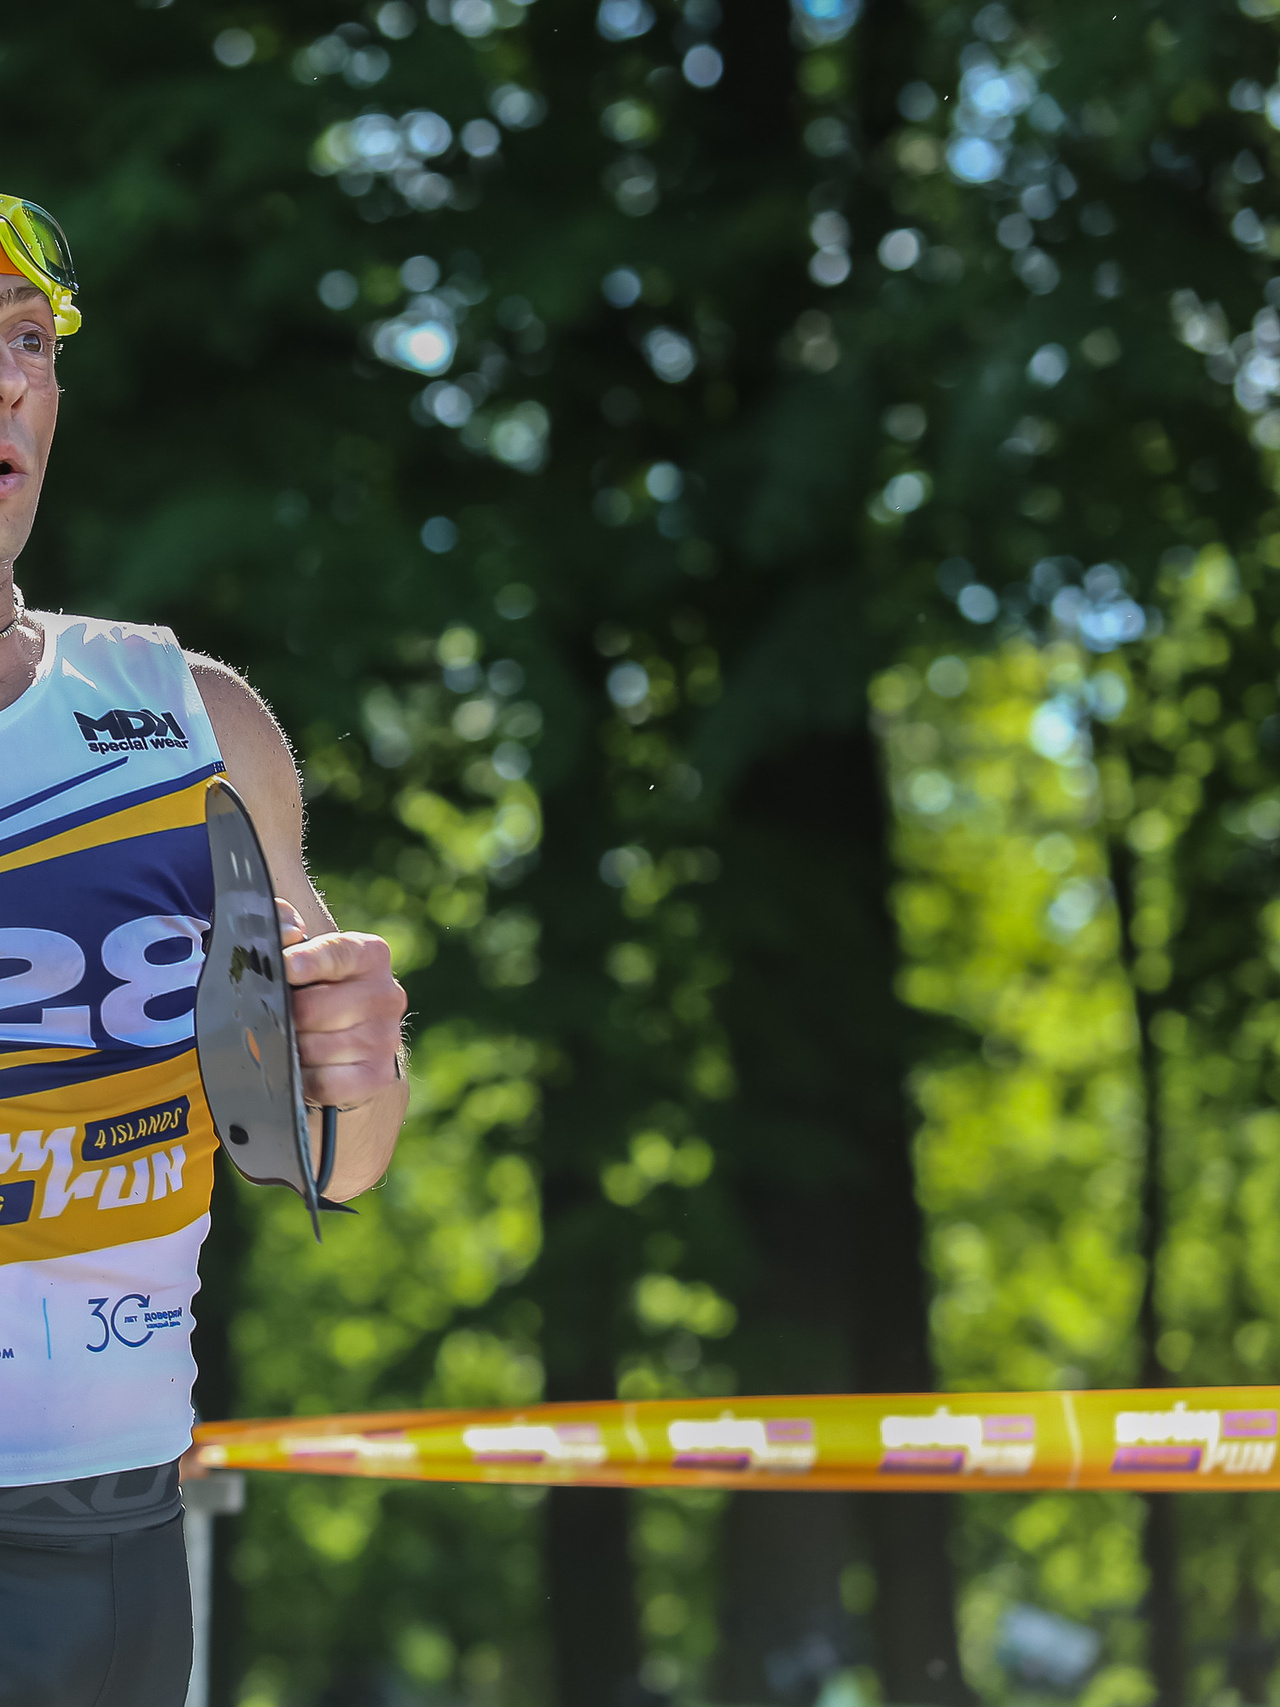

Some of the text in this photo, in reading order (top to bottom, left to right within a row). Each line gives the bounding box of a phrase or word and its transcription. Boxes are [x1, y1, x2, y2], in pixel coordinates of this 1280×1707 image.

[88, 737, 189, 754] special wear
[94, 1107, 182, 1149] 4 ISLANDS
